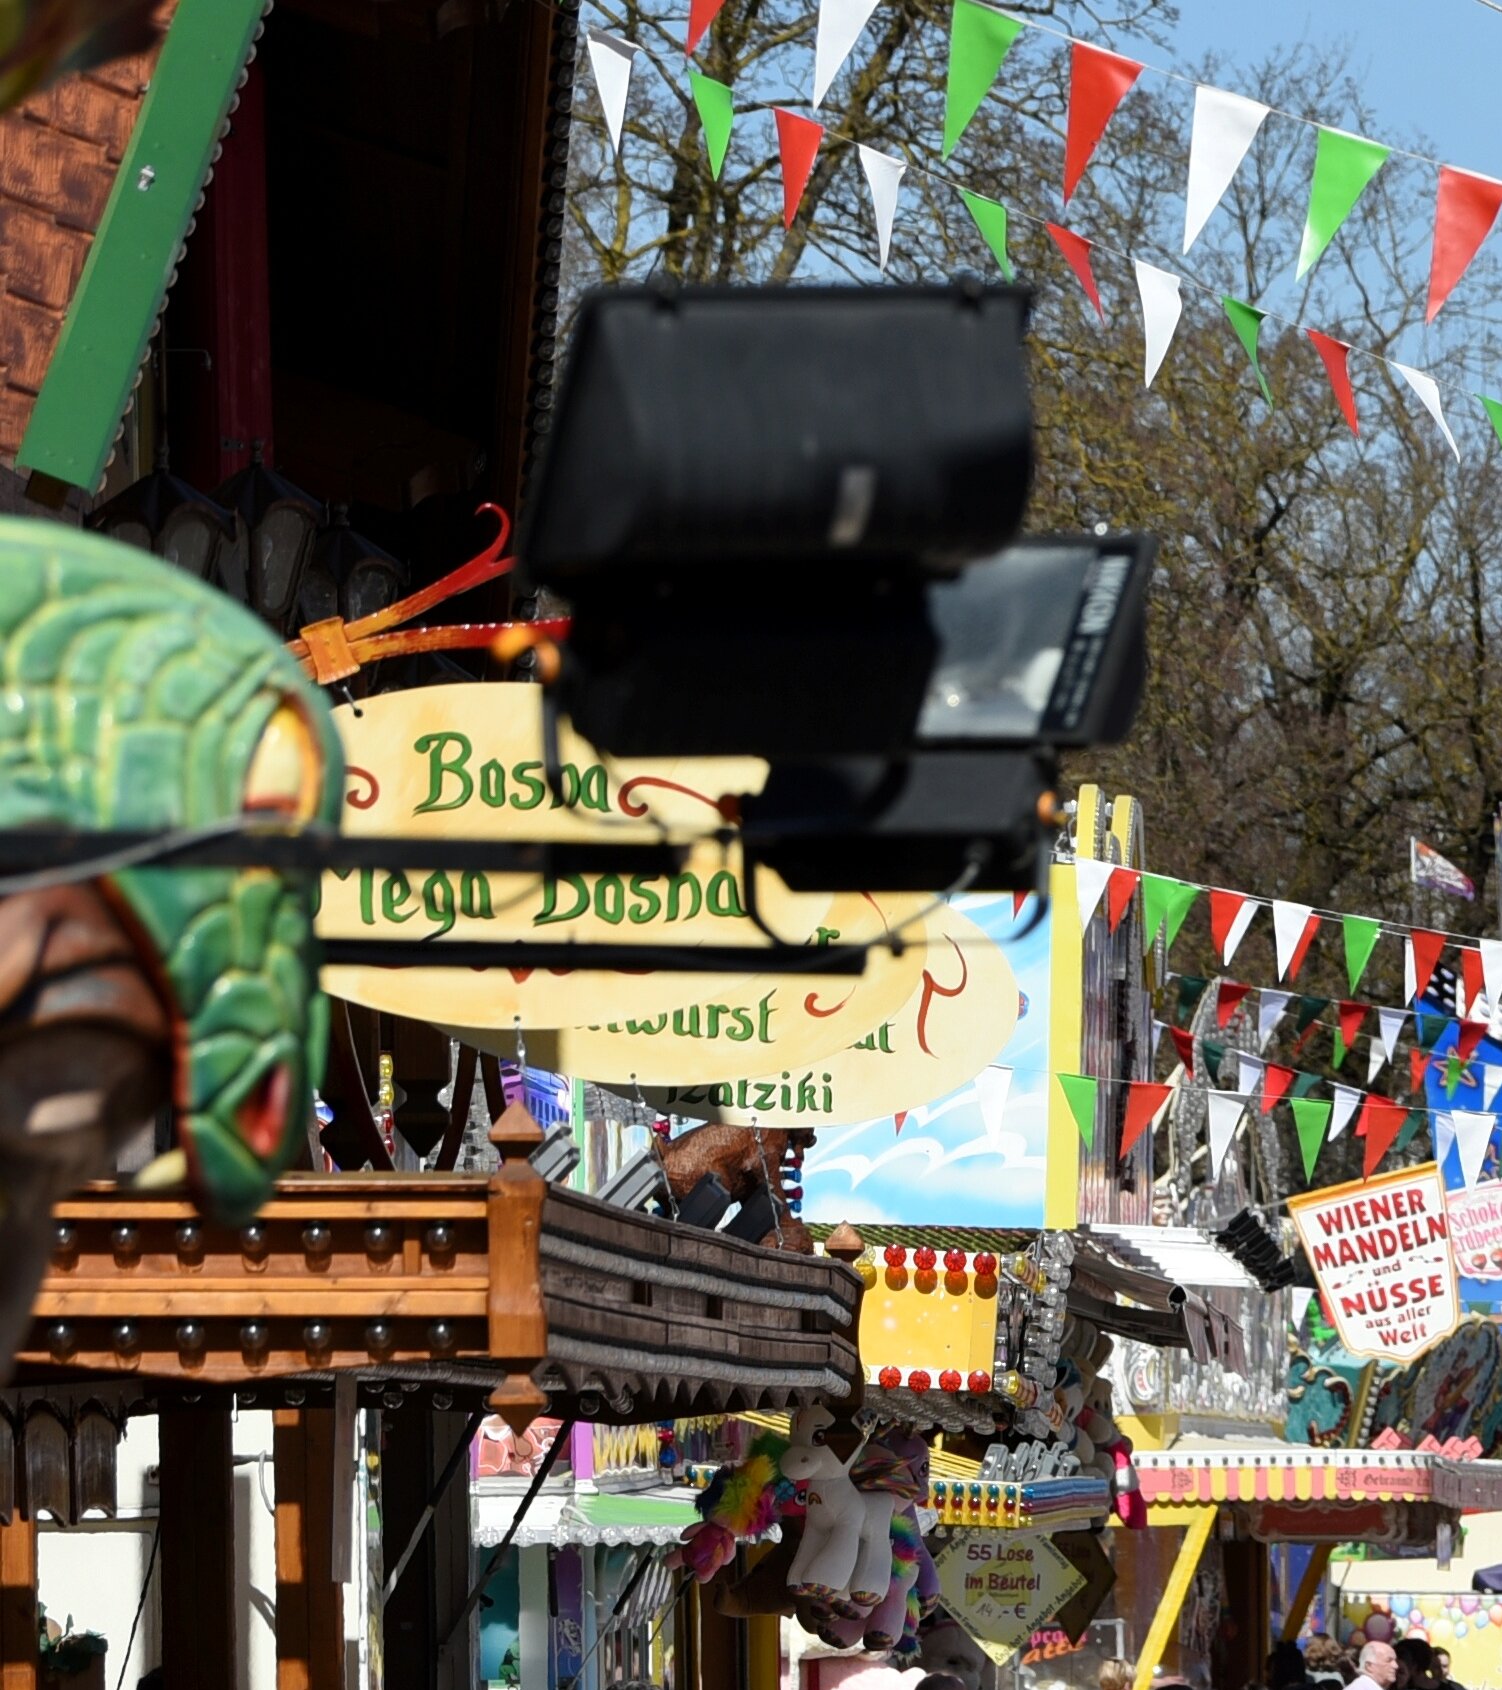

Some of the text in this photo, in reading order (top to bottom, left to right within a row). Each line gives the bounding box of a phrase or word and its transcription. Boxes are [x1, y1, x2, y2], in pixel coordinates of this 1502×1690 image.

[1317, 1188, 1427, 1237] WIENER
[1312, 1213, 1448, 1272] MANDELN
[1373, 1260, 1402, 1277] und
[1340, 1275, 1446, 1318] NÜSSE
[1365, 1305, 1432, 1329] aus aller
[1378, 1323, 1428, 1347] Welt
[967, 1543, 992, 1561] 55
[997, 1543, 1034, 1562] Lose
[965, 1572, 1041, 1591] im Beutel
[1014, 1602, 1026, 1619] €
